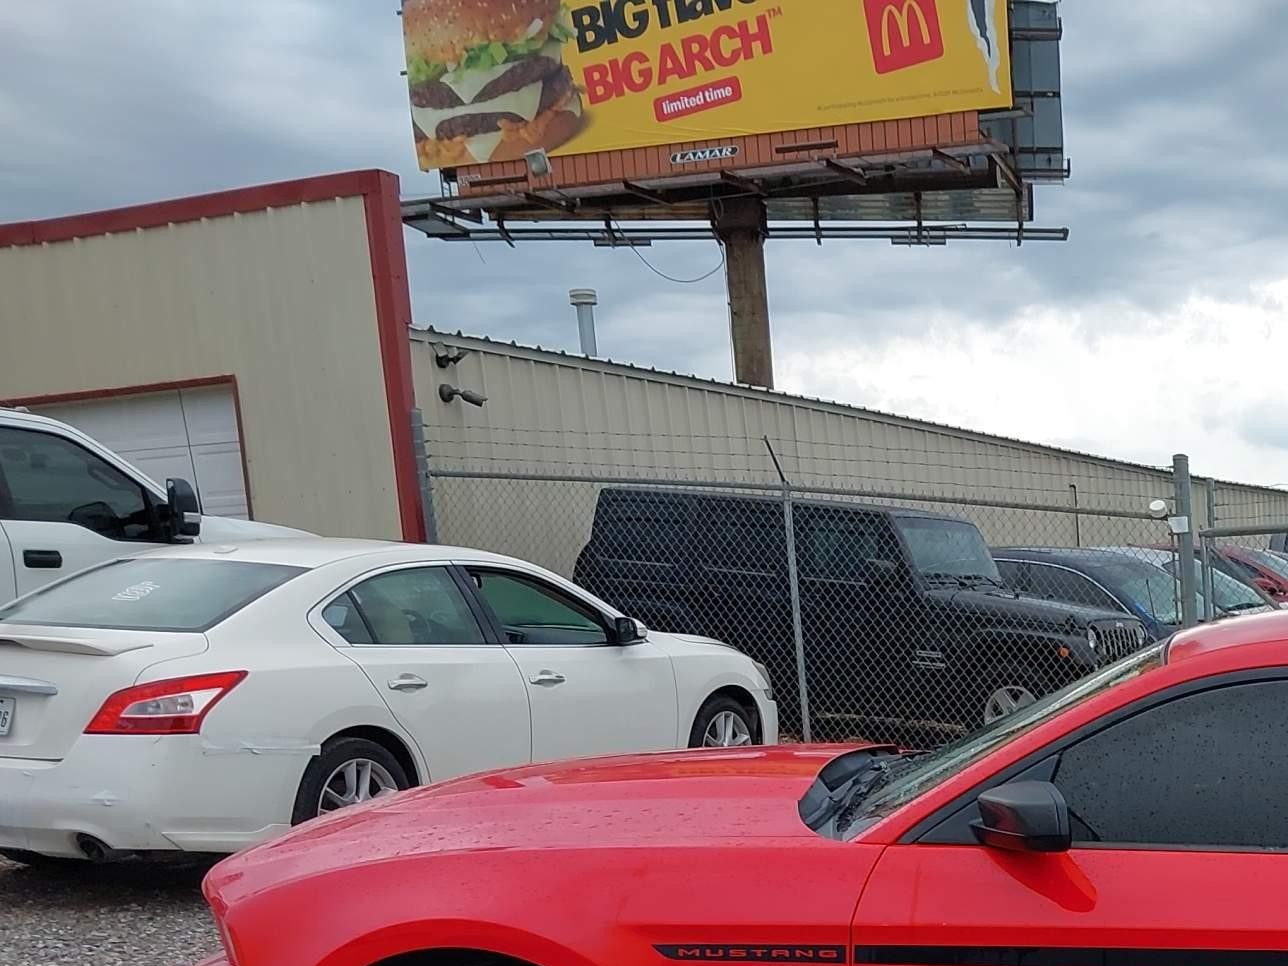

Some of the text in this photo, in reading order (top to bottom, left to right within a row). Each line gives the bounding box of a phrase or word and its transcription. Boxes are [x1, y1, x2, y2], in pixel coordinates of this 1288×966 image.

[571, 0, 650, 53] BIG
[583, 51, 653, 105] BIG
[662, 86, 733, 114] limited time
[676, 147, 732, 162] LAMAR
[677, 948, 838, 959] MUSTANG
